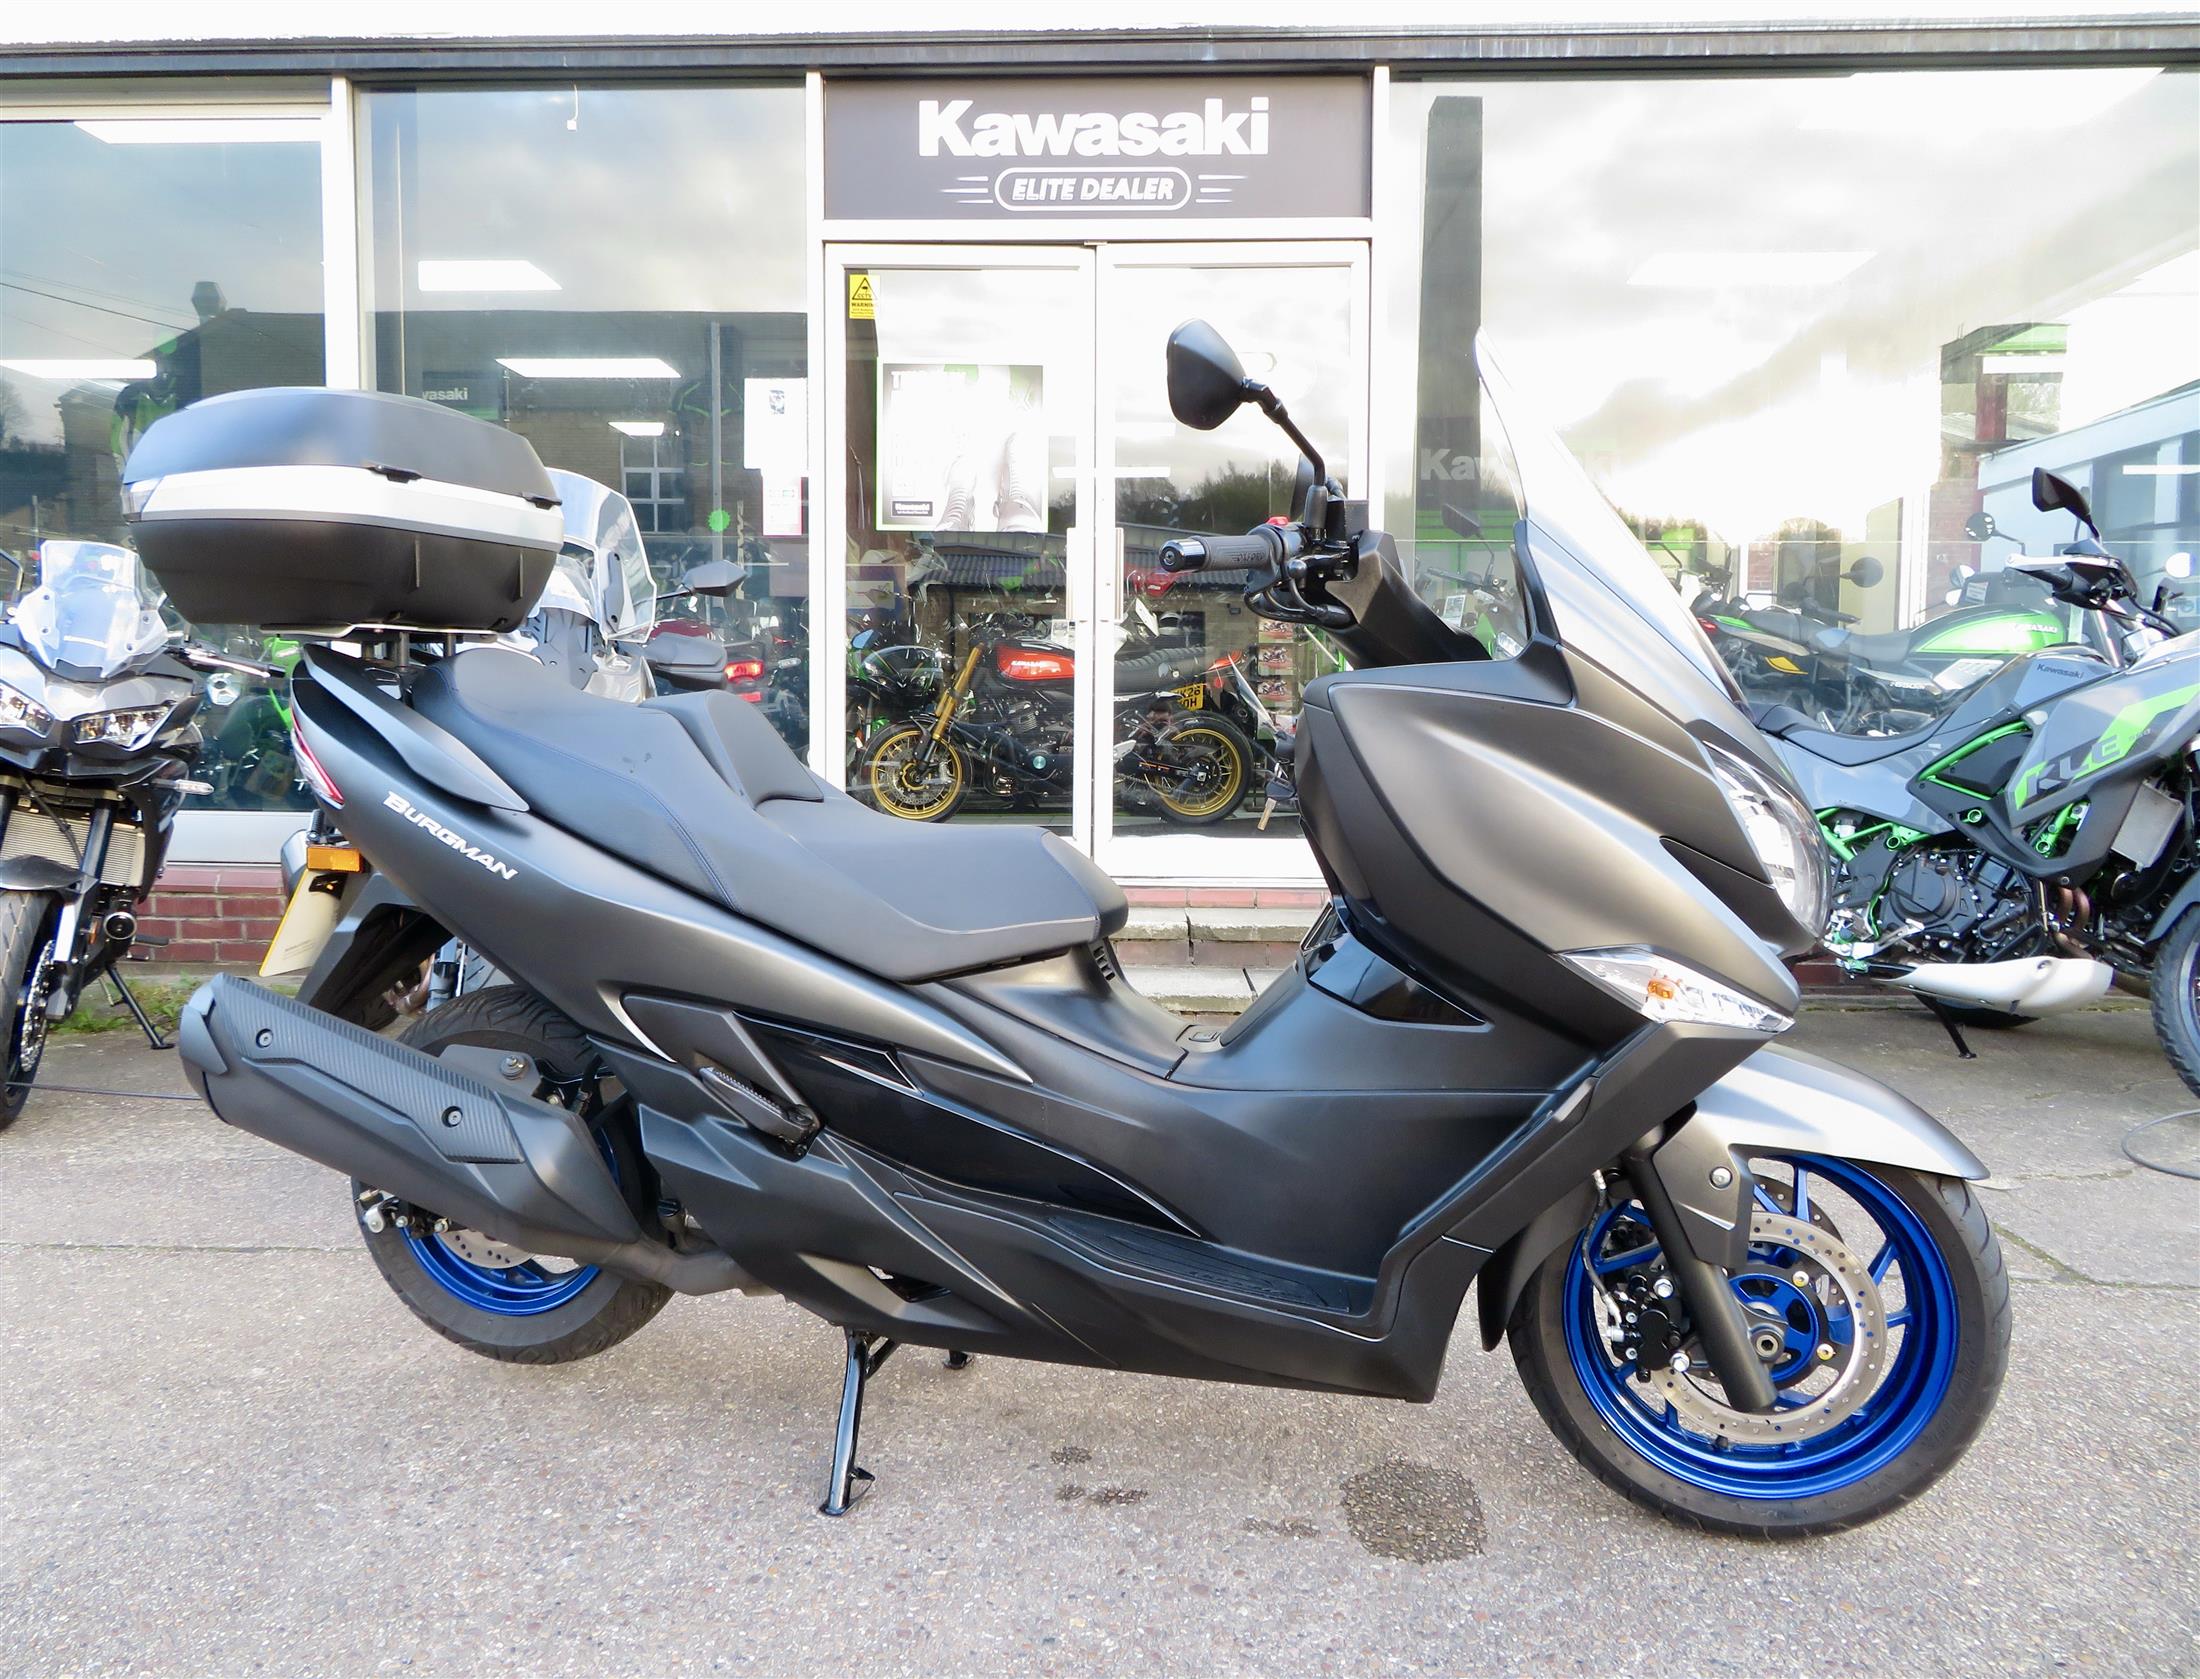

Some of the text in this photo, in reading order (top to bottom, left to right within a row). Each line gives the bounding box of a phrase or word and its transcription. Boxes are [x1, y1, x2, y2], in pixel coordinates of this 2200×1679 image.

[919, 97, 1269, 157] Kawasaki
[1012, 178, 1175, 201] ELITE DEALER
[1178, 683, 1201, 698] K26
[2036, 663, 2084, 679] Kawasaki
[2025, 735, 2122, 797] KLE
[383, 790, 519, 880] BURGMAN
